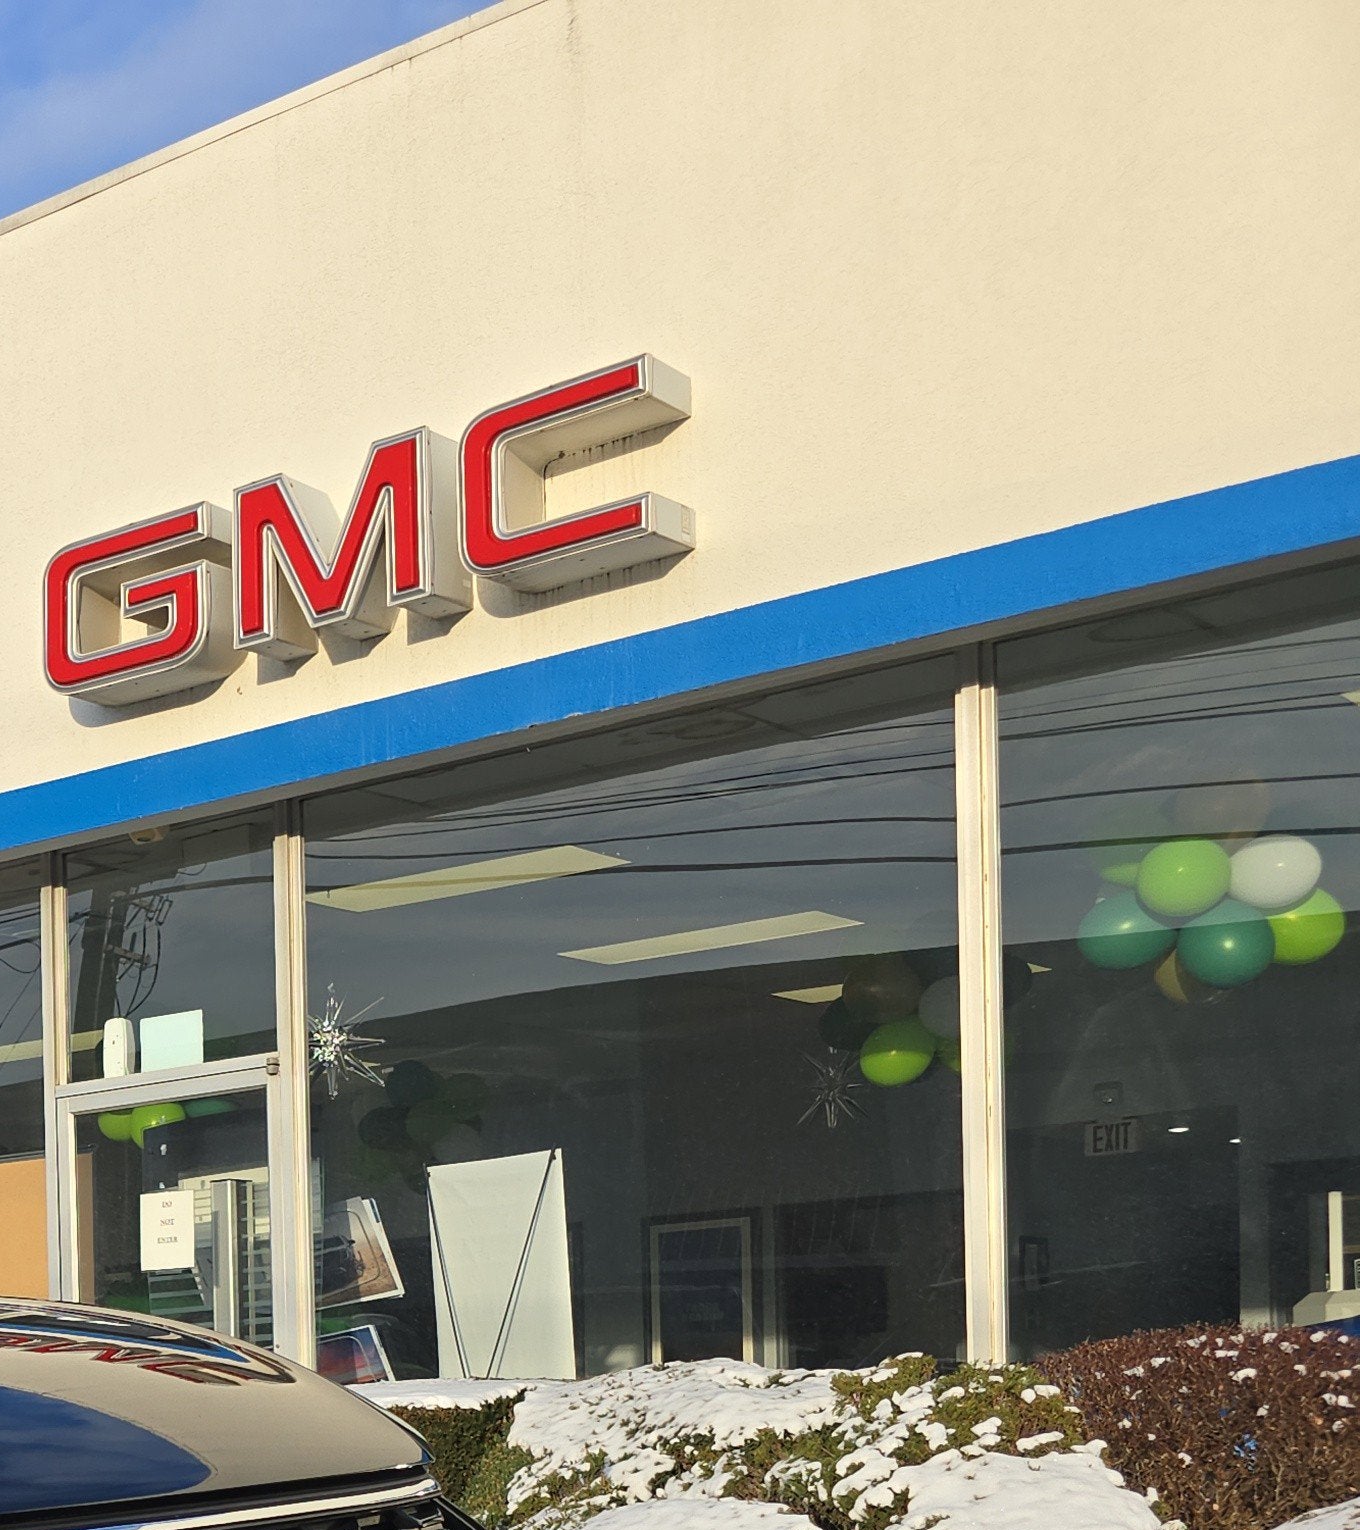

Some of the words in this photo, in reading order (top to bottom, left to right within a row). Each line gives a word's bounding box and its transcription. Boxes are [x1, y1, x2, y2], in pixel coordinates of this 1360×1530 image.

[43, 353, 692, 702] GMC
[1092, 1122, 1131, 1154] EXIT
[160, 1218, 175, 1226] NOT
